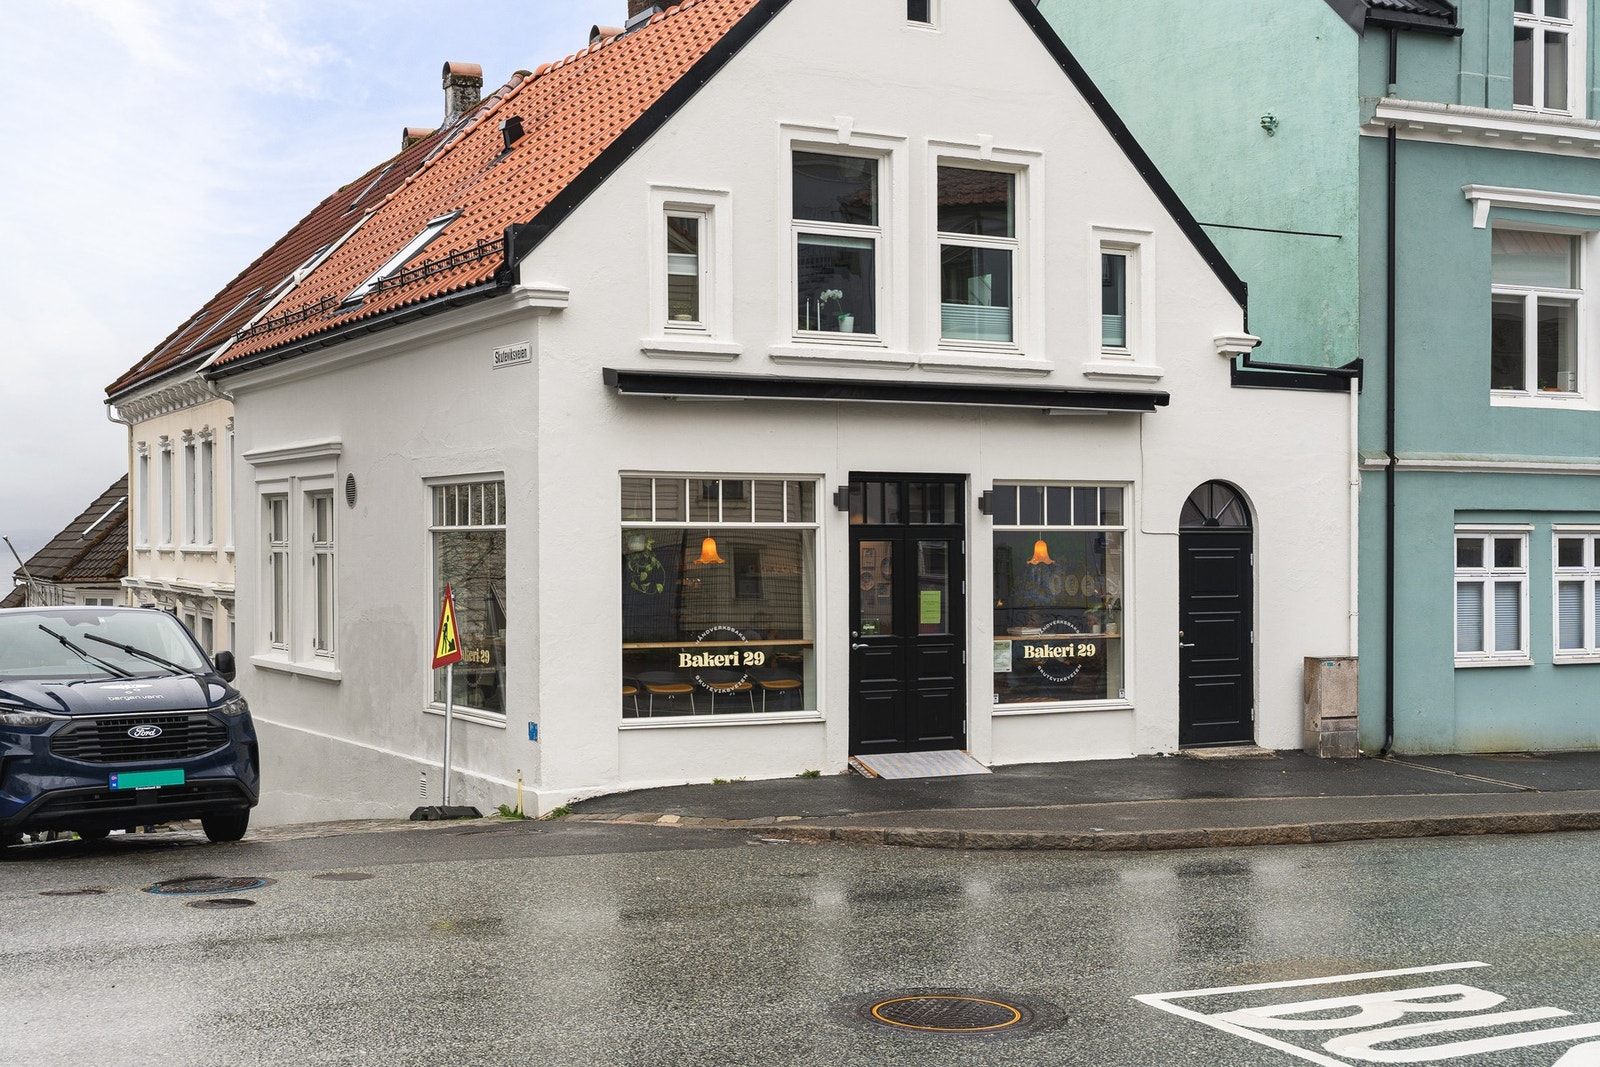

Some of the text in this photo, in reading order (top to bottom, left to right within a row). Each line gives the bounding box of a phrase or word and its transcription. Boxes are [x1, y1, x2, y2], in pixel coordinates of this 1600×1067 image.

[462, 647, 490, 664] keri 29
[678, 650, 765, 668] Bakeri 29
[1023, 643, 1075, 659] Bakeri
[1077, 643, 1096, 657] 29
[134, 727, 157, 737] Ford
[1208, 984, 1600, 1067] BU
